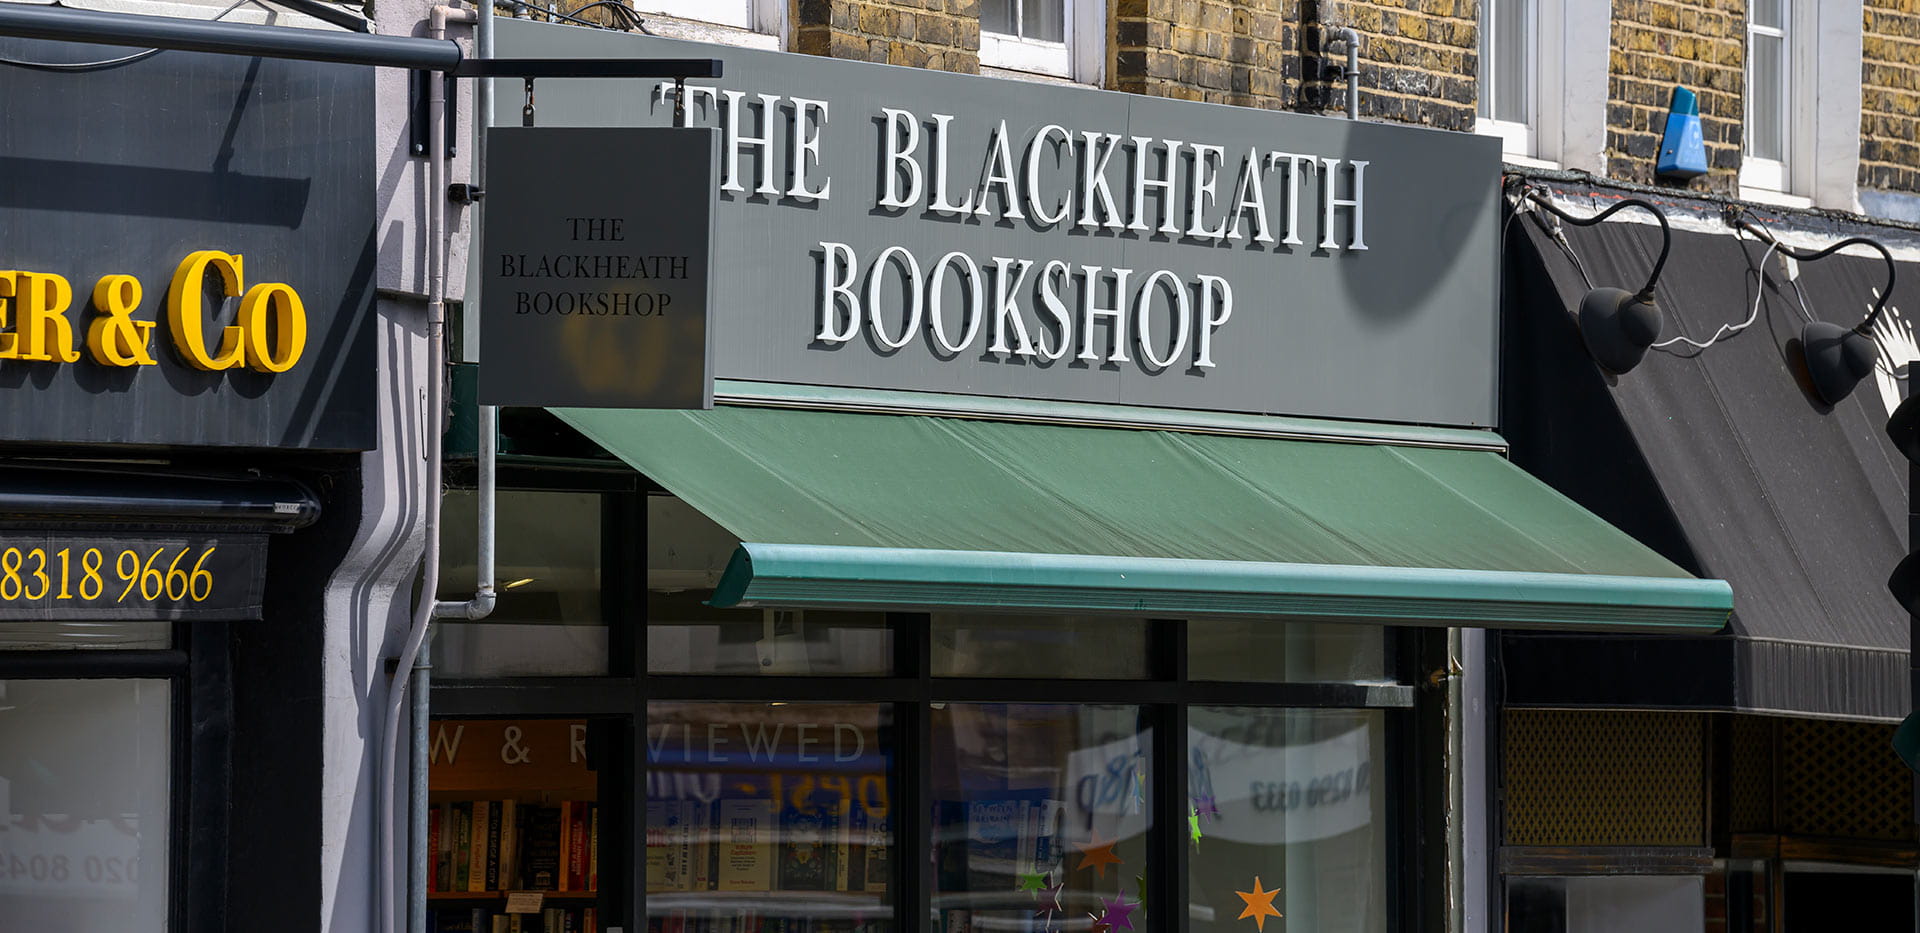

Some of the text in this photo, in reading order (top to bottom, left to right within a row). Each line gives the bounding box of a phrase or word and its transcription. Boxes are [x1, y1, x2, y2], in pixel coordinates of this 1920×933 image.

[661, 81, 1370, 251] THE BLACKHEATH
[566, 217, 625, 242] THE
[500, 254, 689, 280] BLACKHEATH
[87, 274, 158, 367] &
[515, 291, 672, 316] BOOKSHOP
[815, 241, 1233, 368] BOOKSHOP
[0, 546, 217, 603] 8318 9666
[500, 725, 530, 764] &
